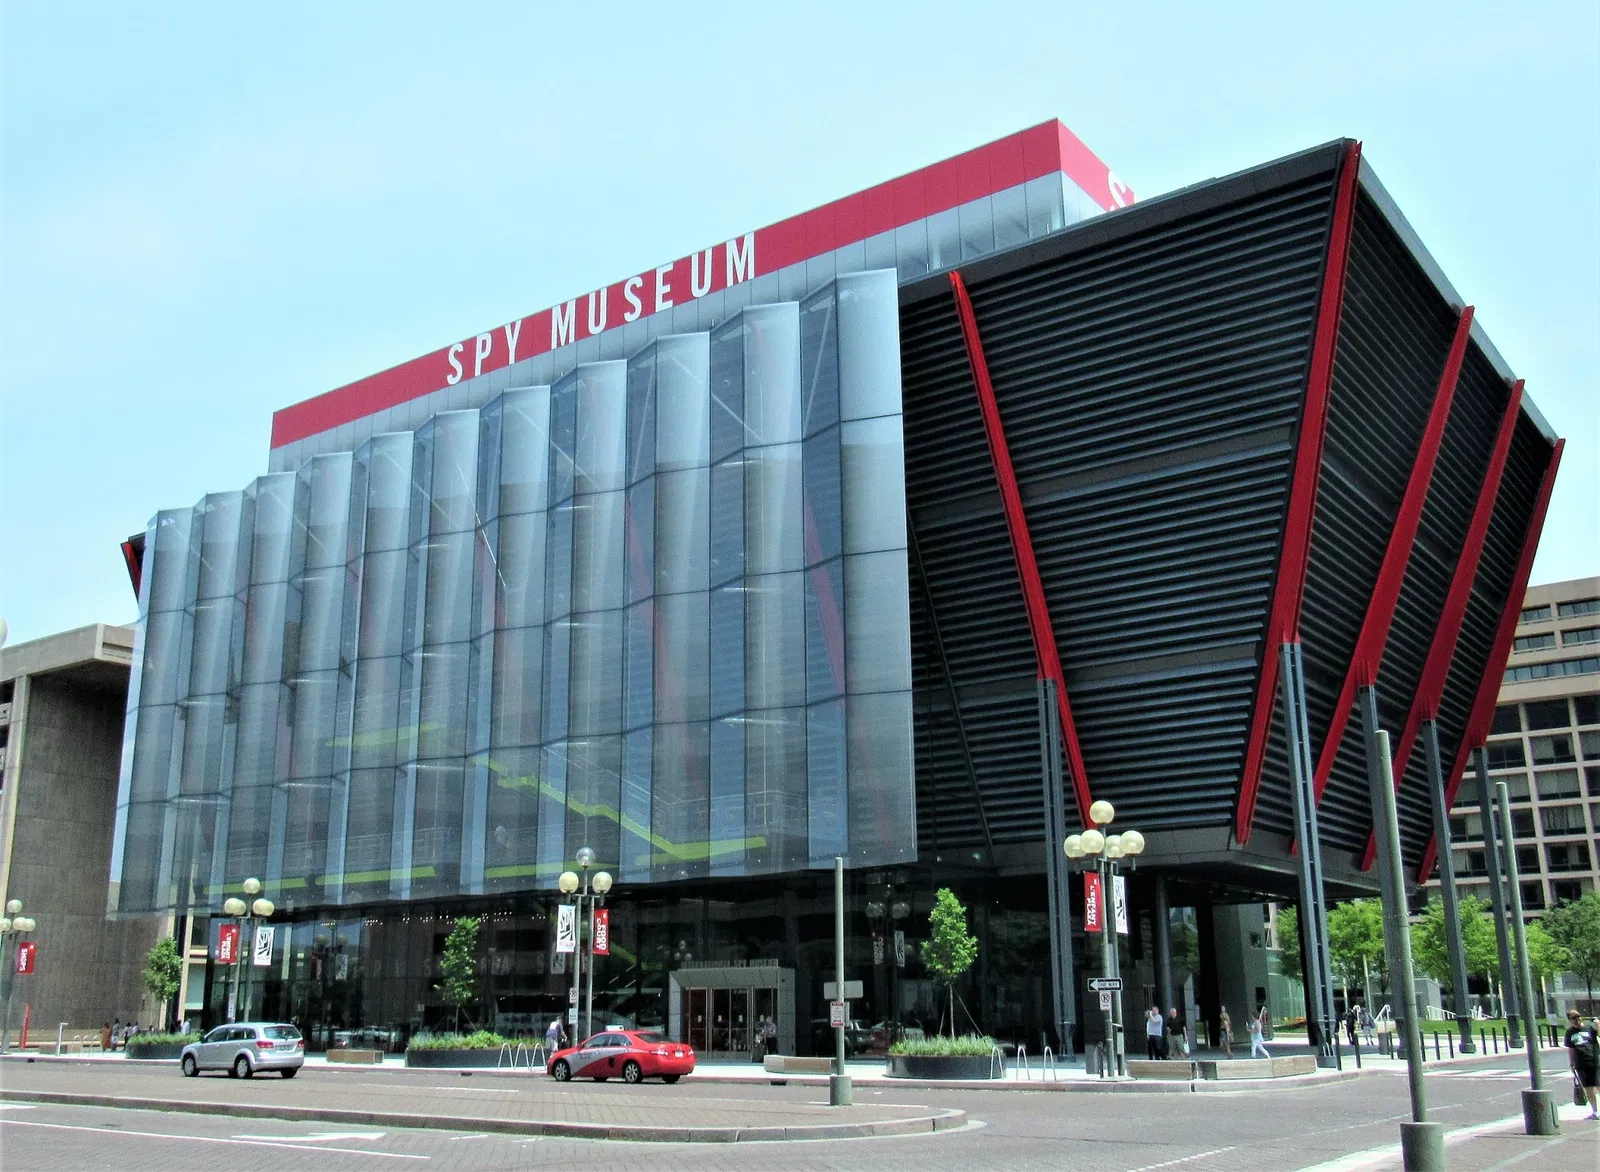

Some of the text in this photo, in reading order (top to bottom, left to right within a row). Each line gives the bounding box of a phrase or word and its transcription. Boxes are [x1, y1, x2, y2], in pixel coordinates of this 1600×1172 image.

[446, 231, 755, 385] SPY MUSEUM
[19, 948, 28, 971] SHOPS
